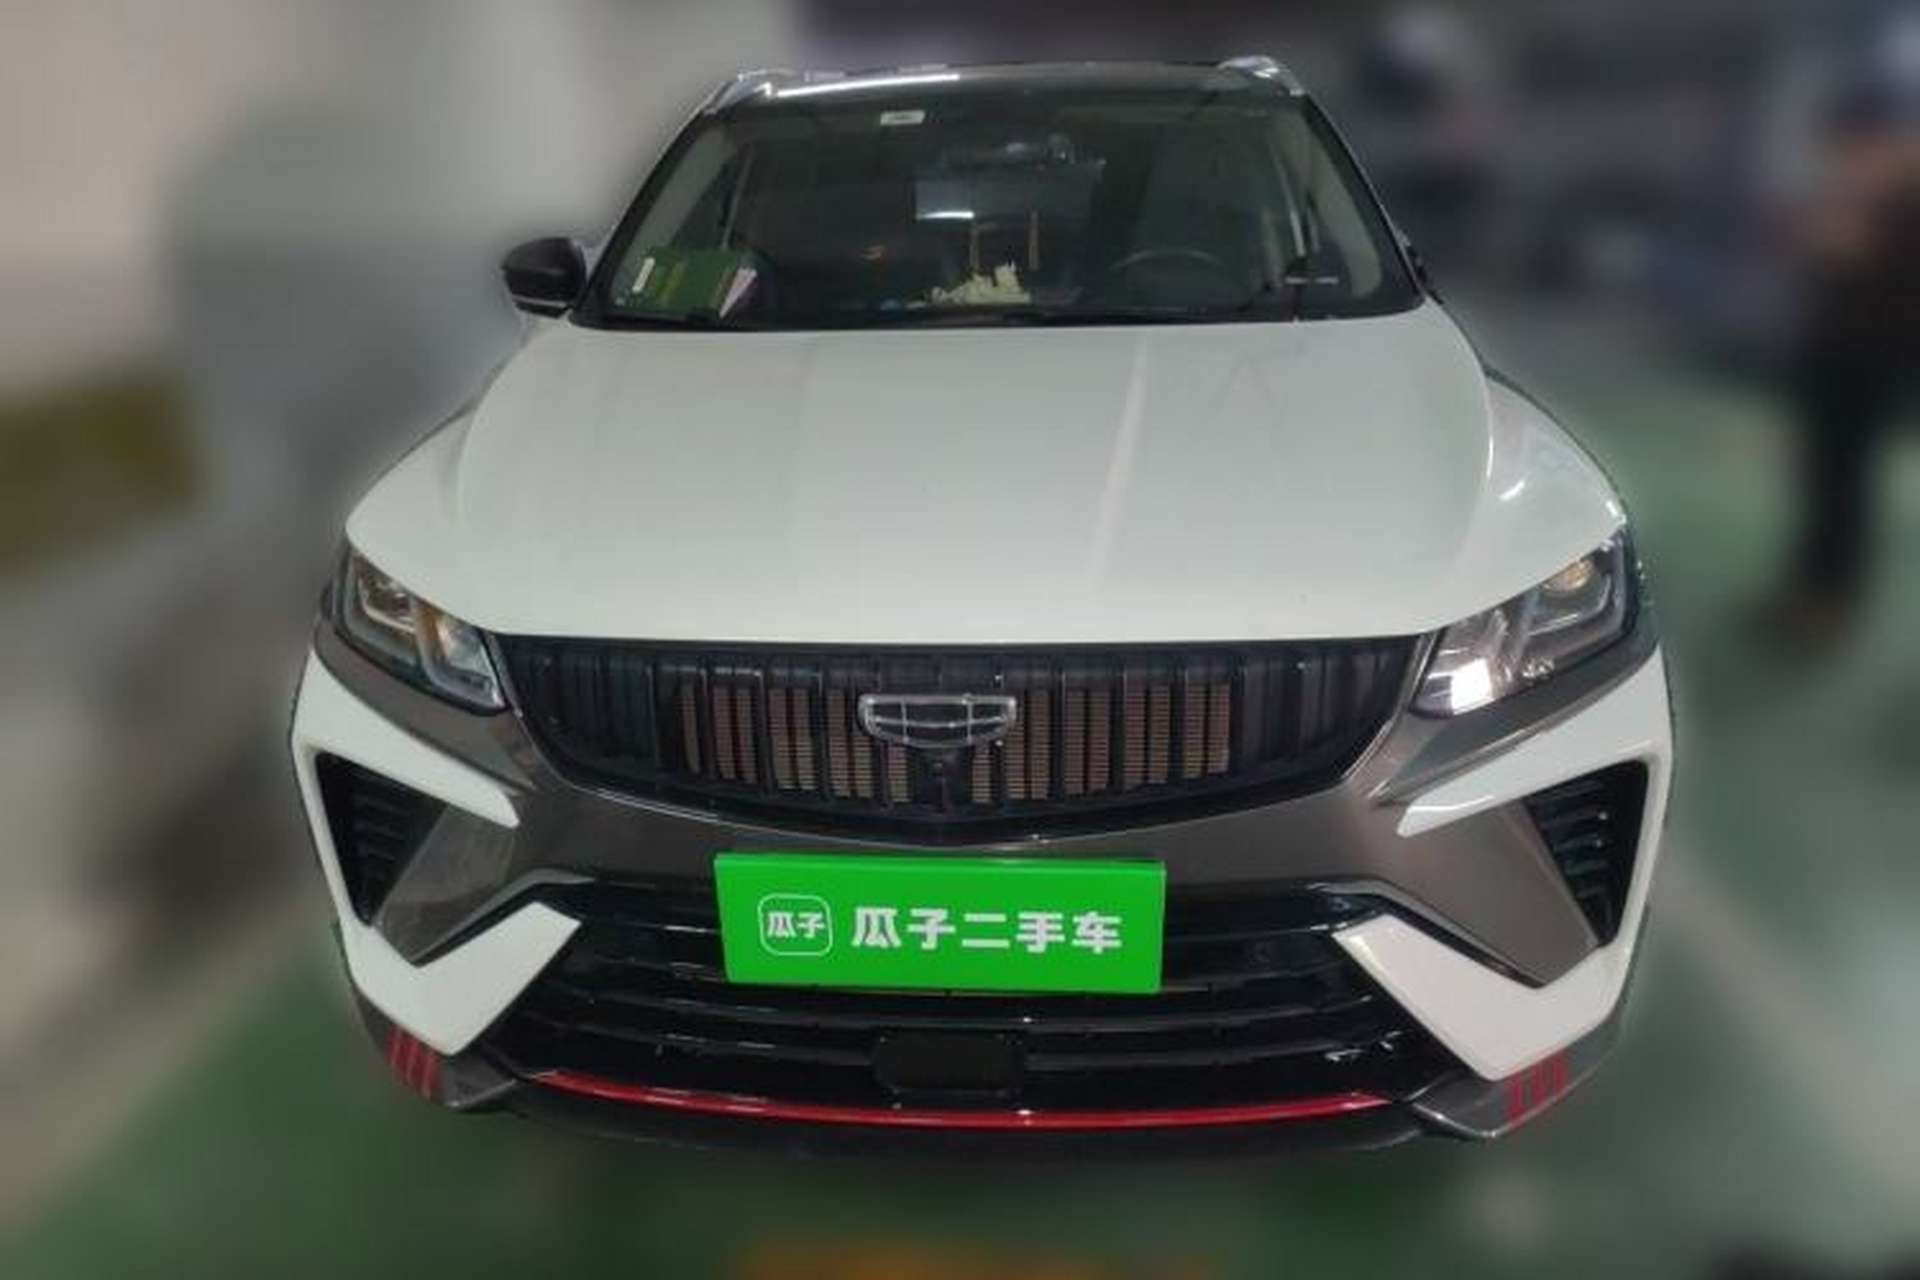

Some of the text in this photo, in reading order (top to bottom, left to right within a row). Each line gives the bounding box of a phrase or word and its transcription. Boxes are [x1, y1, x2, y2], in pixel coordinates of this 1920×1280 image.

[767, 911, 825, 939] 瓜子
[851, 906, 1122, 953] 瓜子二手车
